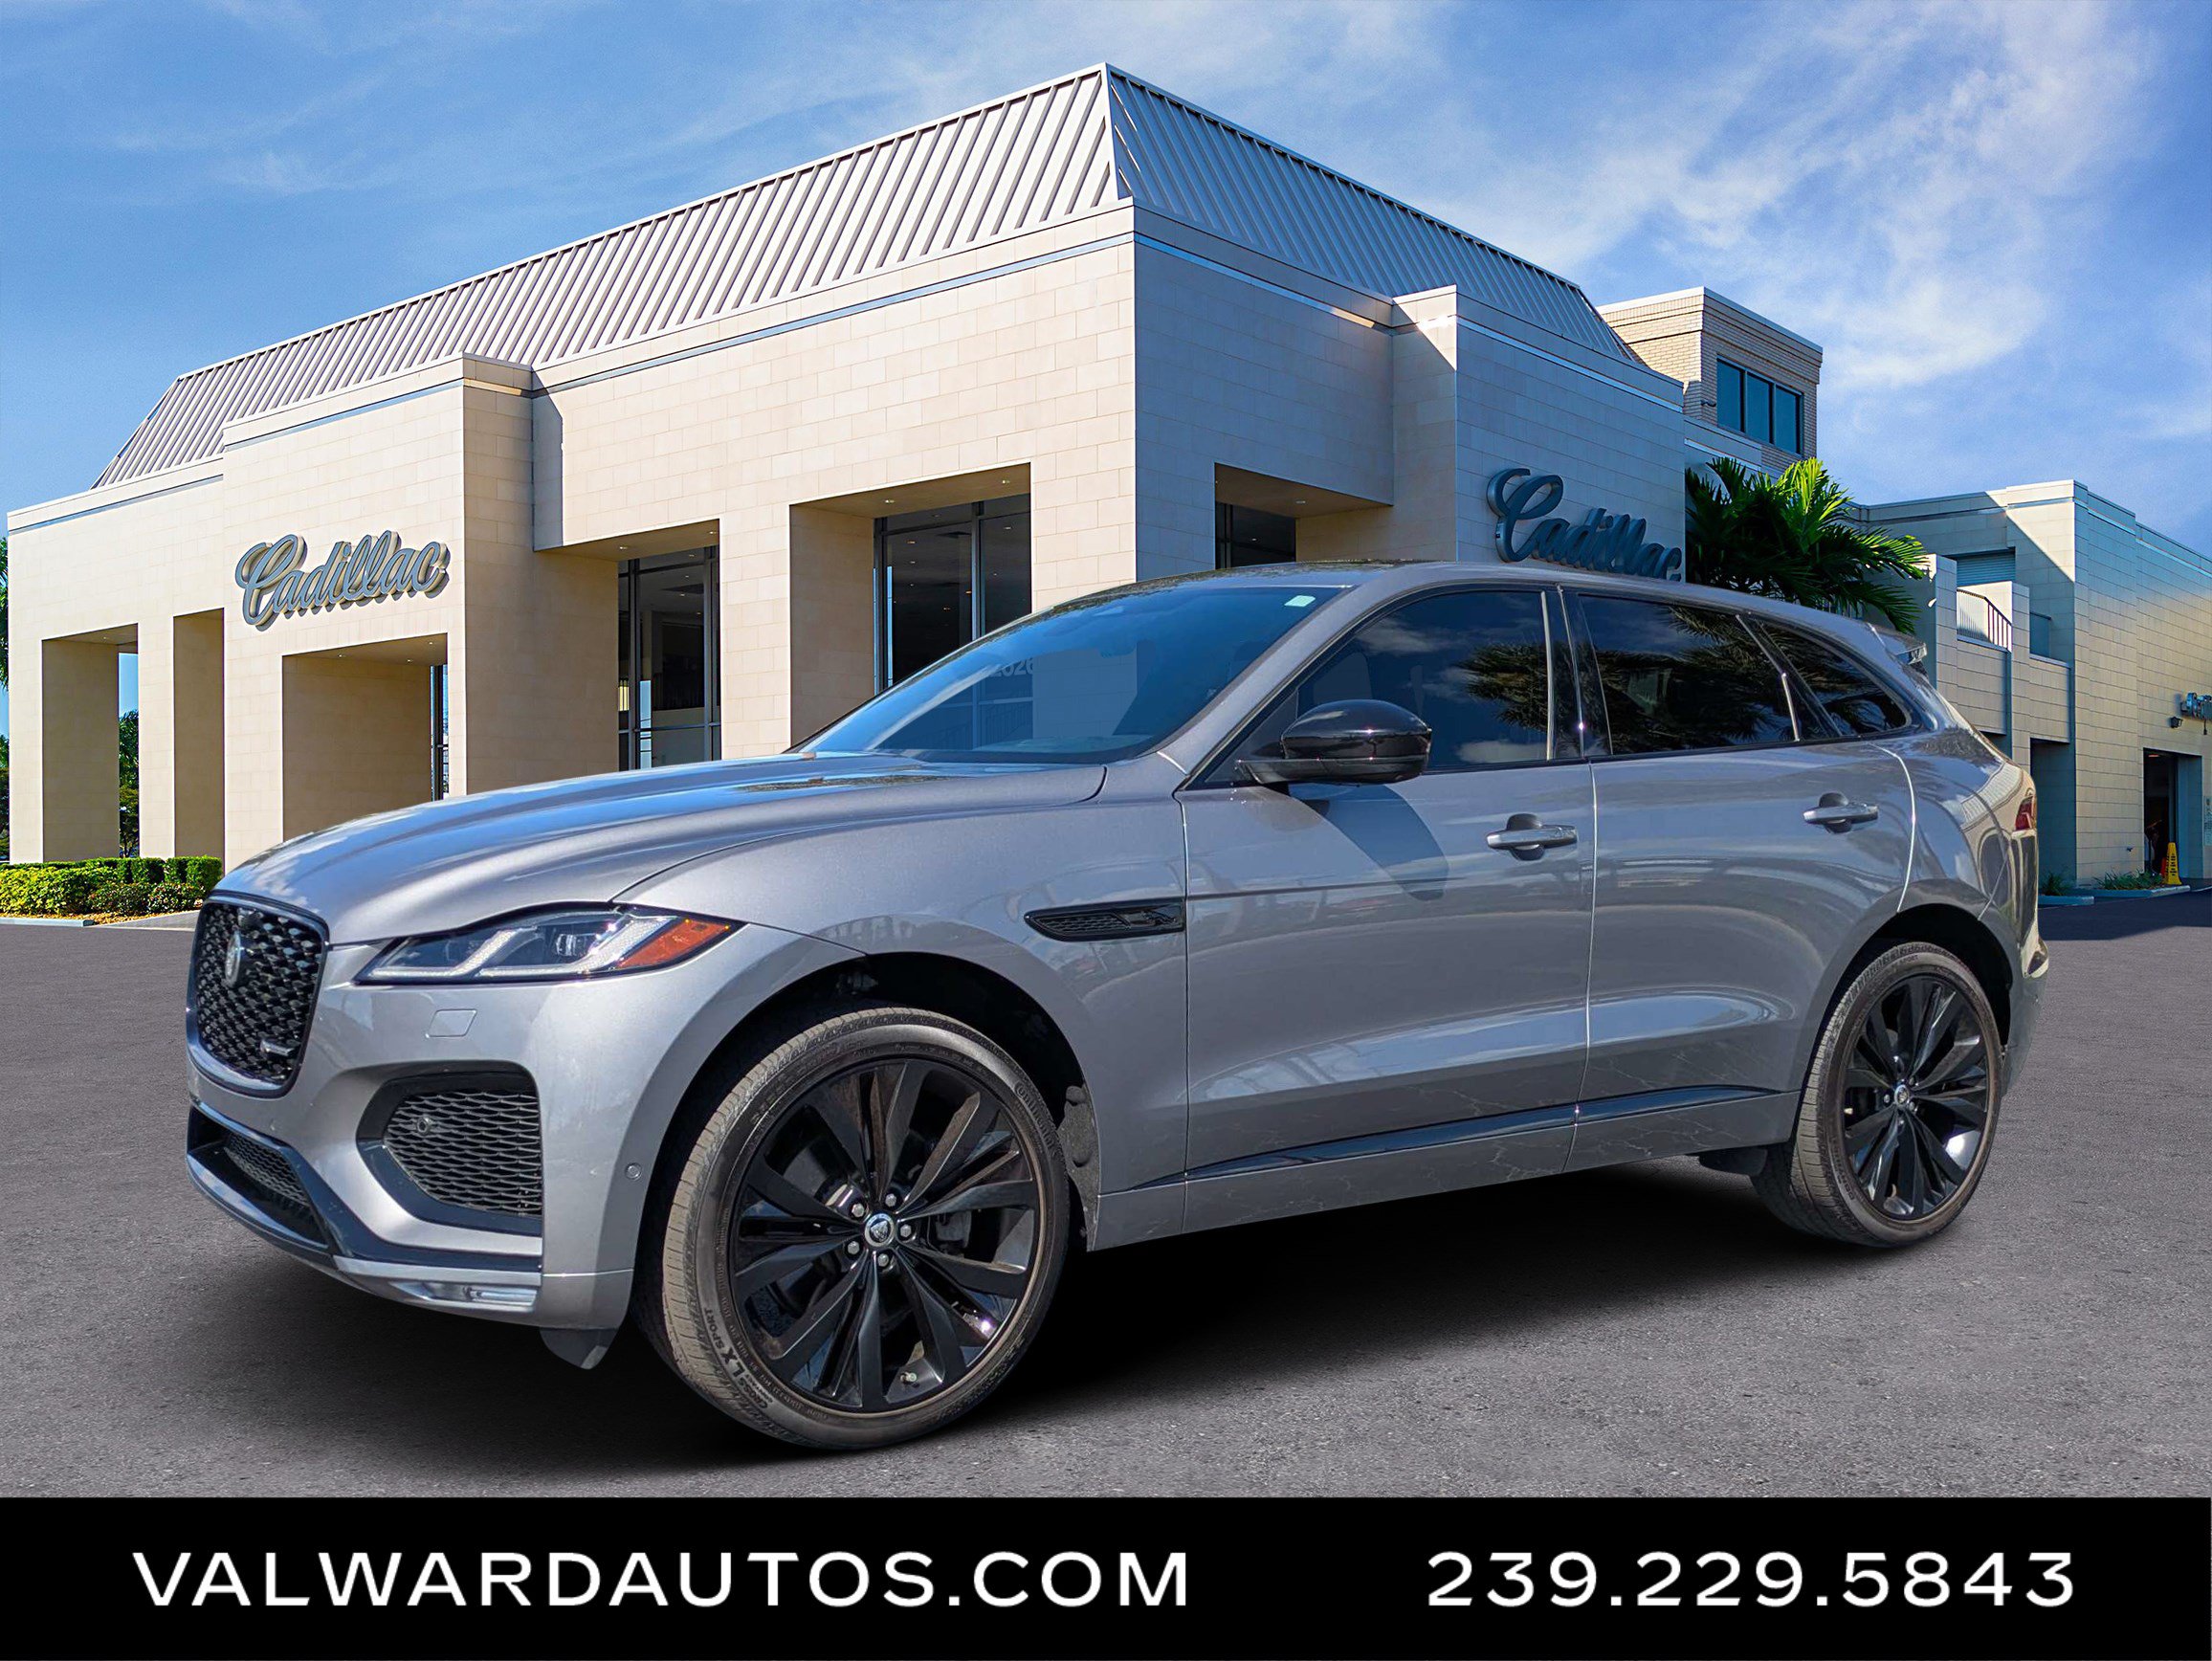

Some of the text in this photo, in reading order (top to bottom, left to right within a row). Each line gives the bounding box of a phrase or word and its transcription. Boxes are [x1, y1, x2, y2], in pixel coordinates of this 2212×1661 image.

[1487, 468, 1682, 582] Cadillac
[234, 529, 449, 628] Cadillac
[703, 1307, 725, 1350] SPORT
